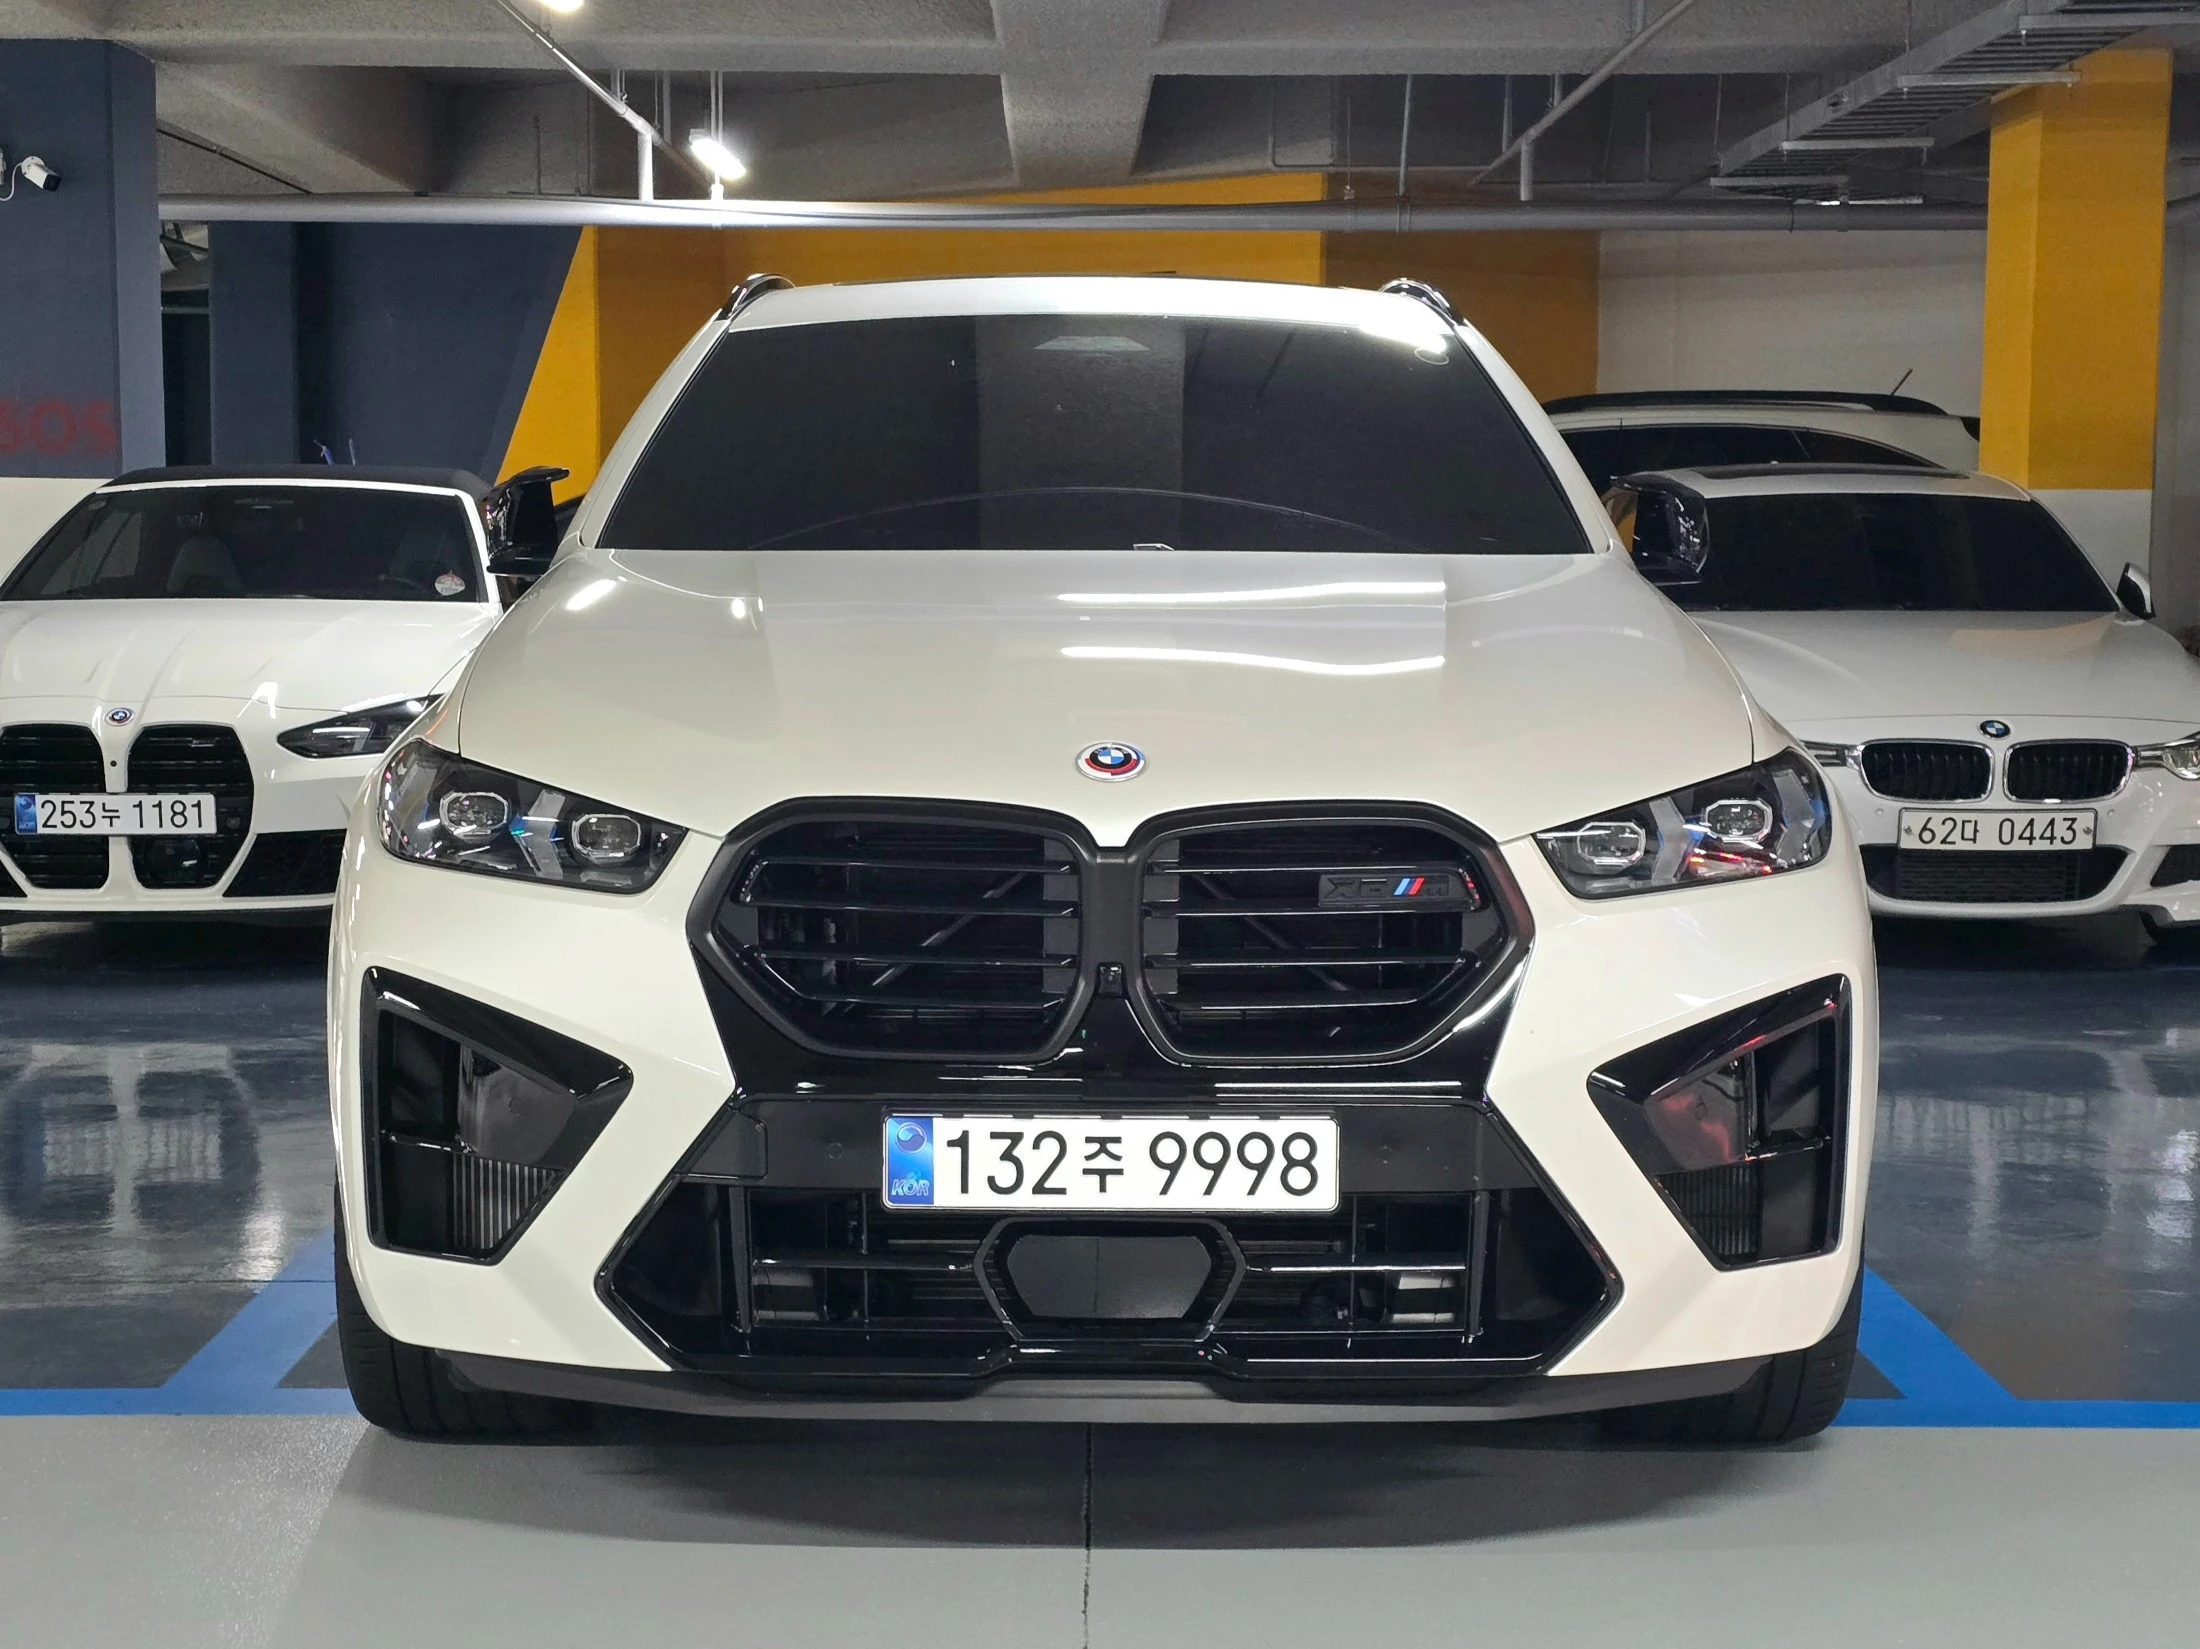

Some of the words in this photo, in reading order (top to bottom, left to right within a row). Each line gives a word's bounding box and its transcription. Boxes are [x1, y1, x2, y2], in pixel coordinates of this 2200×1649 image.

[40, 799, 121, 829] 253누
[132, 799, 204, 829] 1181
[1917, 816, 1980, 846] 62다
[1998, 816, 2078, 846] 0443
[945, 1129, 1125, 1196] 132주
[1148, 1130, 1319, 1197] 9998
[891, 1178, 930, 1197] KOR
